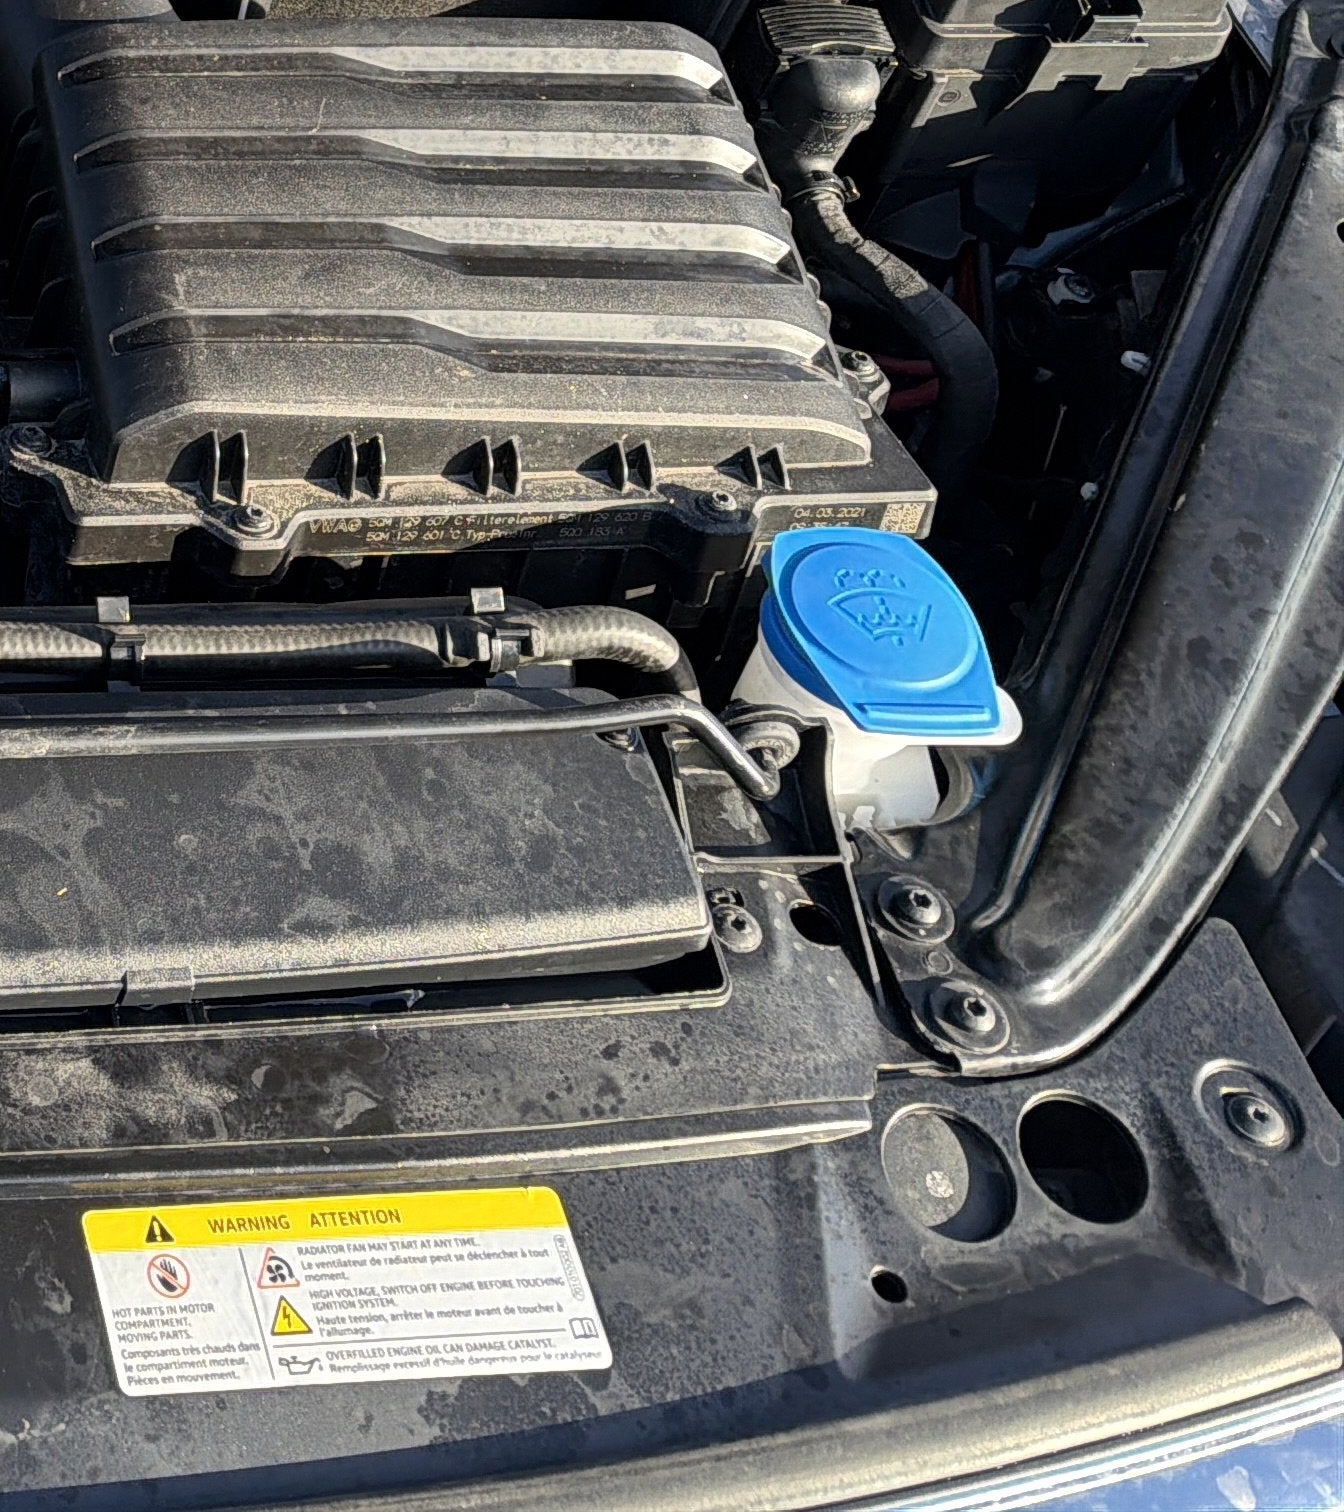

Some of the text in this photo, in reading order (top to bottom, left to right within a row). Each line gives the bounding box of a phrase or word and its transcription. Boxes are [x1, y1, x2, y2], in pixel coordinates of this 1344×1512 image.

[399, 516, 421, 528] 129
[425, 516, 449, 527] 607
[396, 530, 418, 542] 129
[208, 1208, 402, 1234] WARNING ATTENTION
[297, 1244, 345, 1256] RADIATOR
[347, 1242, 367, 1253] FAN
[367, 1241, 388, 1252] MAY
[389, 1239, 418, 1251] START
[420, 1239, 431, 1249] AT
[433, 1237, 453, 1249] ANY
[301, 1261, 313, 1271] Le
[315, 1257, 367, 1271] ventilateur
[369, 1256, 381, 1266] de
[384, 1253, 427, 1265] radiateur
[430, 1253, 452, 1265] peut
[454, 1253, 465, 1262] se
[467, 1248, 518, 1261] déclencher
[528, 1248, 549, 1258] tout
[308, 1289, 334, 1300] HIGH
[381, 1284, 418, 1296] SWITCH
[420, 1282, 438, 1292] OFF
[439, 1281, 476, 1293] ENGINE
[477, 1279, 513, 1291] BEFORE
[516, 1277, 565, 1289] TOUCHING
[112, 1302, 215, 1319] HOT PARTS IN MOTOR
[312, 1299, 356, 1312] IGNITION
[316, 1315, 346, 1327] Haute
[424, 1308, 434, 1318] le
[437, 1308, 472, 1318] moteur
[474, 1306, 501, 1317] avant
[503, 1304, 515, 1315] de
[517, 1302, 554, 1314] toucher
[117, 1330, 158, 1343] MOVING
[121, 1346, 181, 1361] Composants
[201, 1342, 236, 1355] chauds
[238, 1340, 260, 1352] dans
[325, 1347, 385, 1361] OVERFILLED
[387, 1345, 423, 1357] ENGINE
[425, 1344, 441, 1355] OIL
[443, 1342, 463, 1354] CAN
[465, 1340, 507, 1353] DAMAGE
[124, 1361, 134, 1372] le
[136, 1358, 207, 1374] compartiment
[161, 1374, 174, 1384] en
